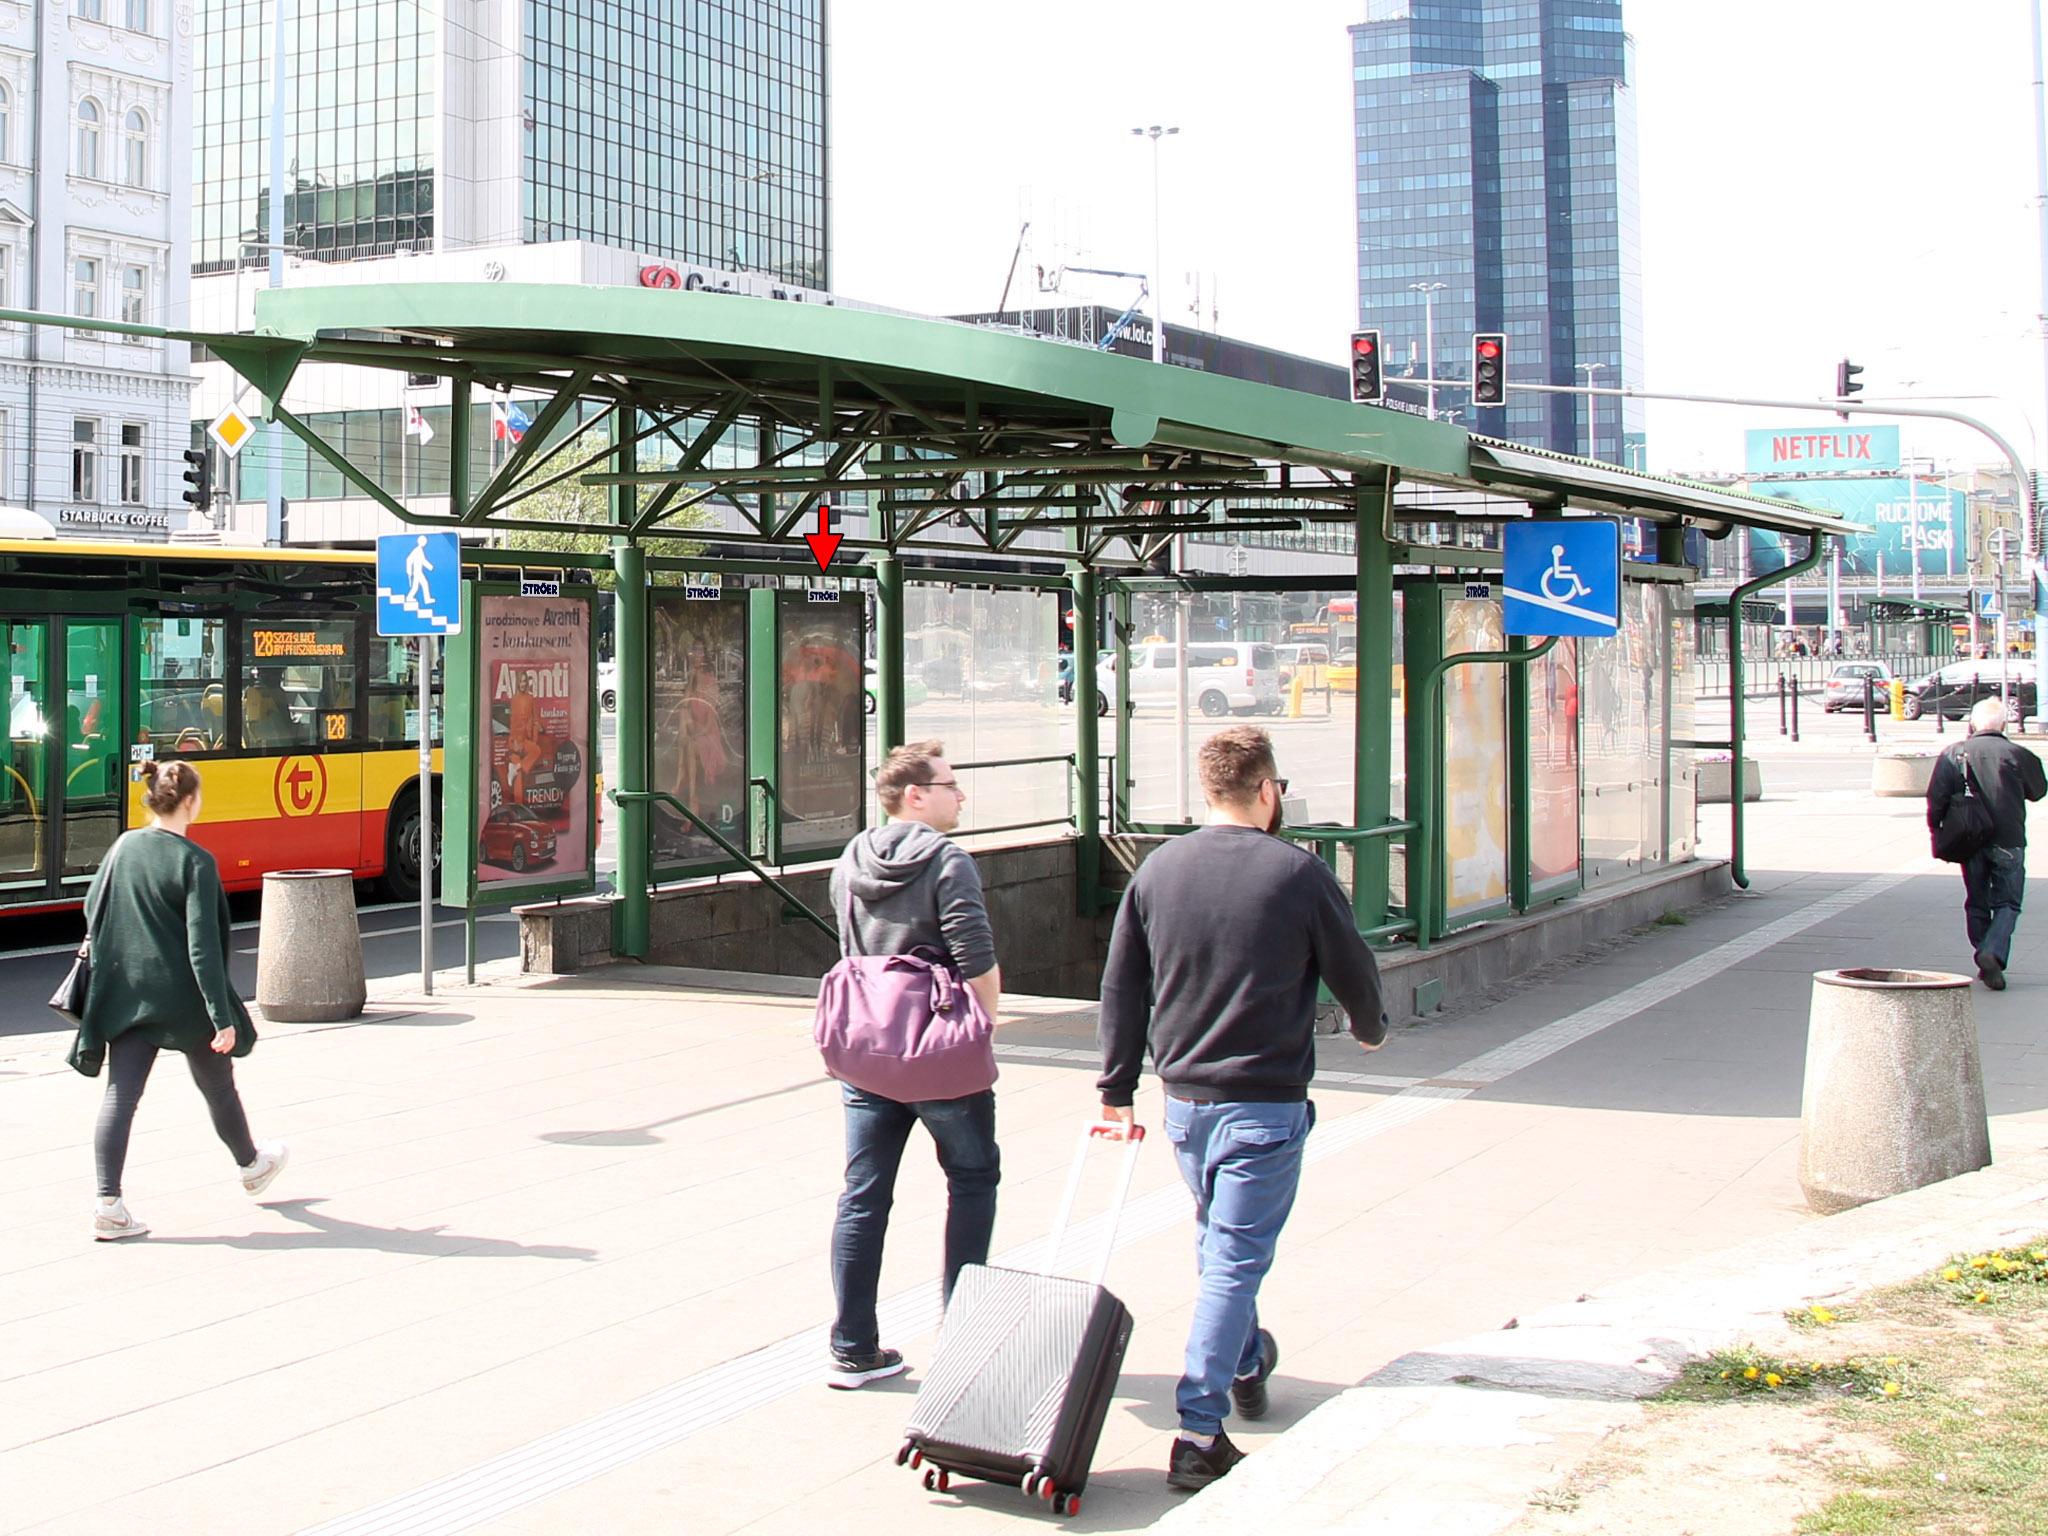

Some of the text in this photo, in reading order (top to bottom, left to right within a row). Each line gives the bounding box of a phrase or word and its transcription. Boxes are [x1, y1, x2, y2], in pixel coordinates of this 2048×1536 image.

[1773, 434, 1871, 462] NETFLIX
[61, 510, 169, 527] STARBUCKS COFFEE
[522, 583, 558, 595] STRÖER
[687, 587, 719, 598] STRÖER
[809, 591, 838, 601] STRÖER
[1466, 585, 1489, 598] STRÖER
[485, 608, 580, 626] urodzinowe Avanti
[253, 631, 273, 656] 128
[503, 631, 572, 649] konkursem!
[326, 714, 345, 739] 128
